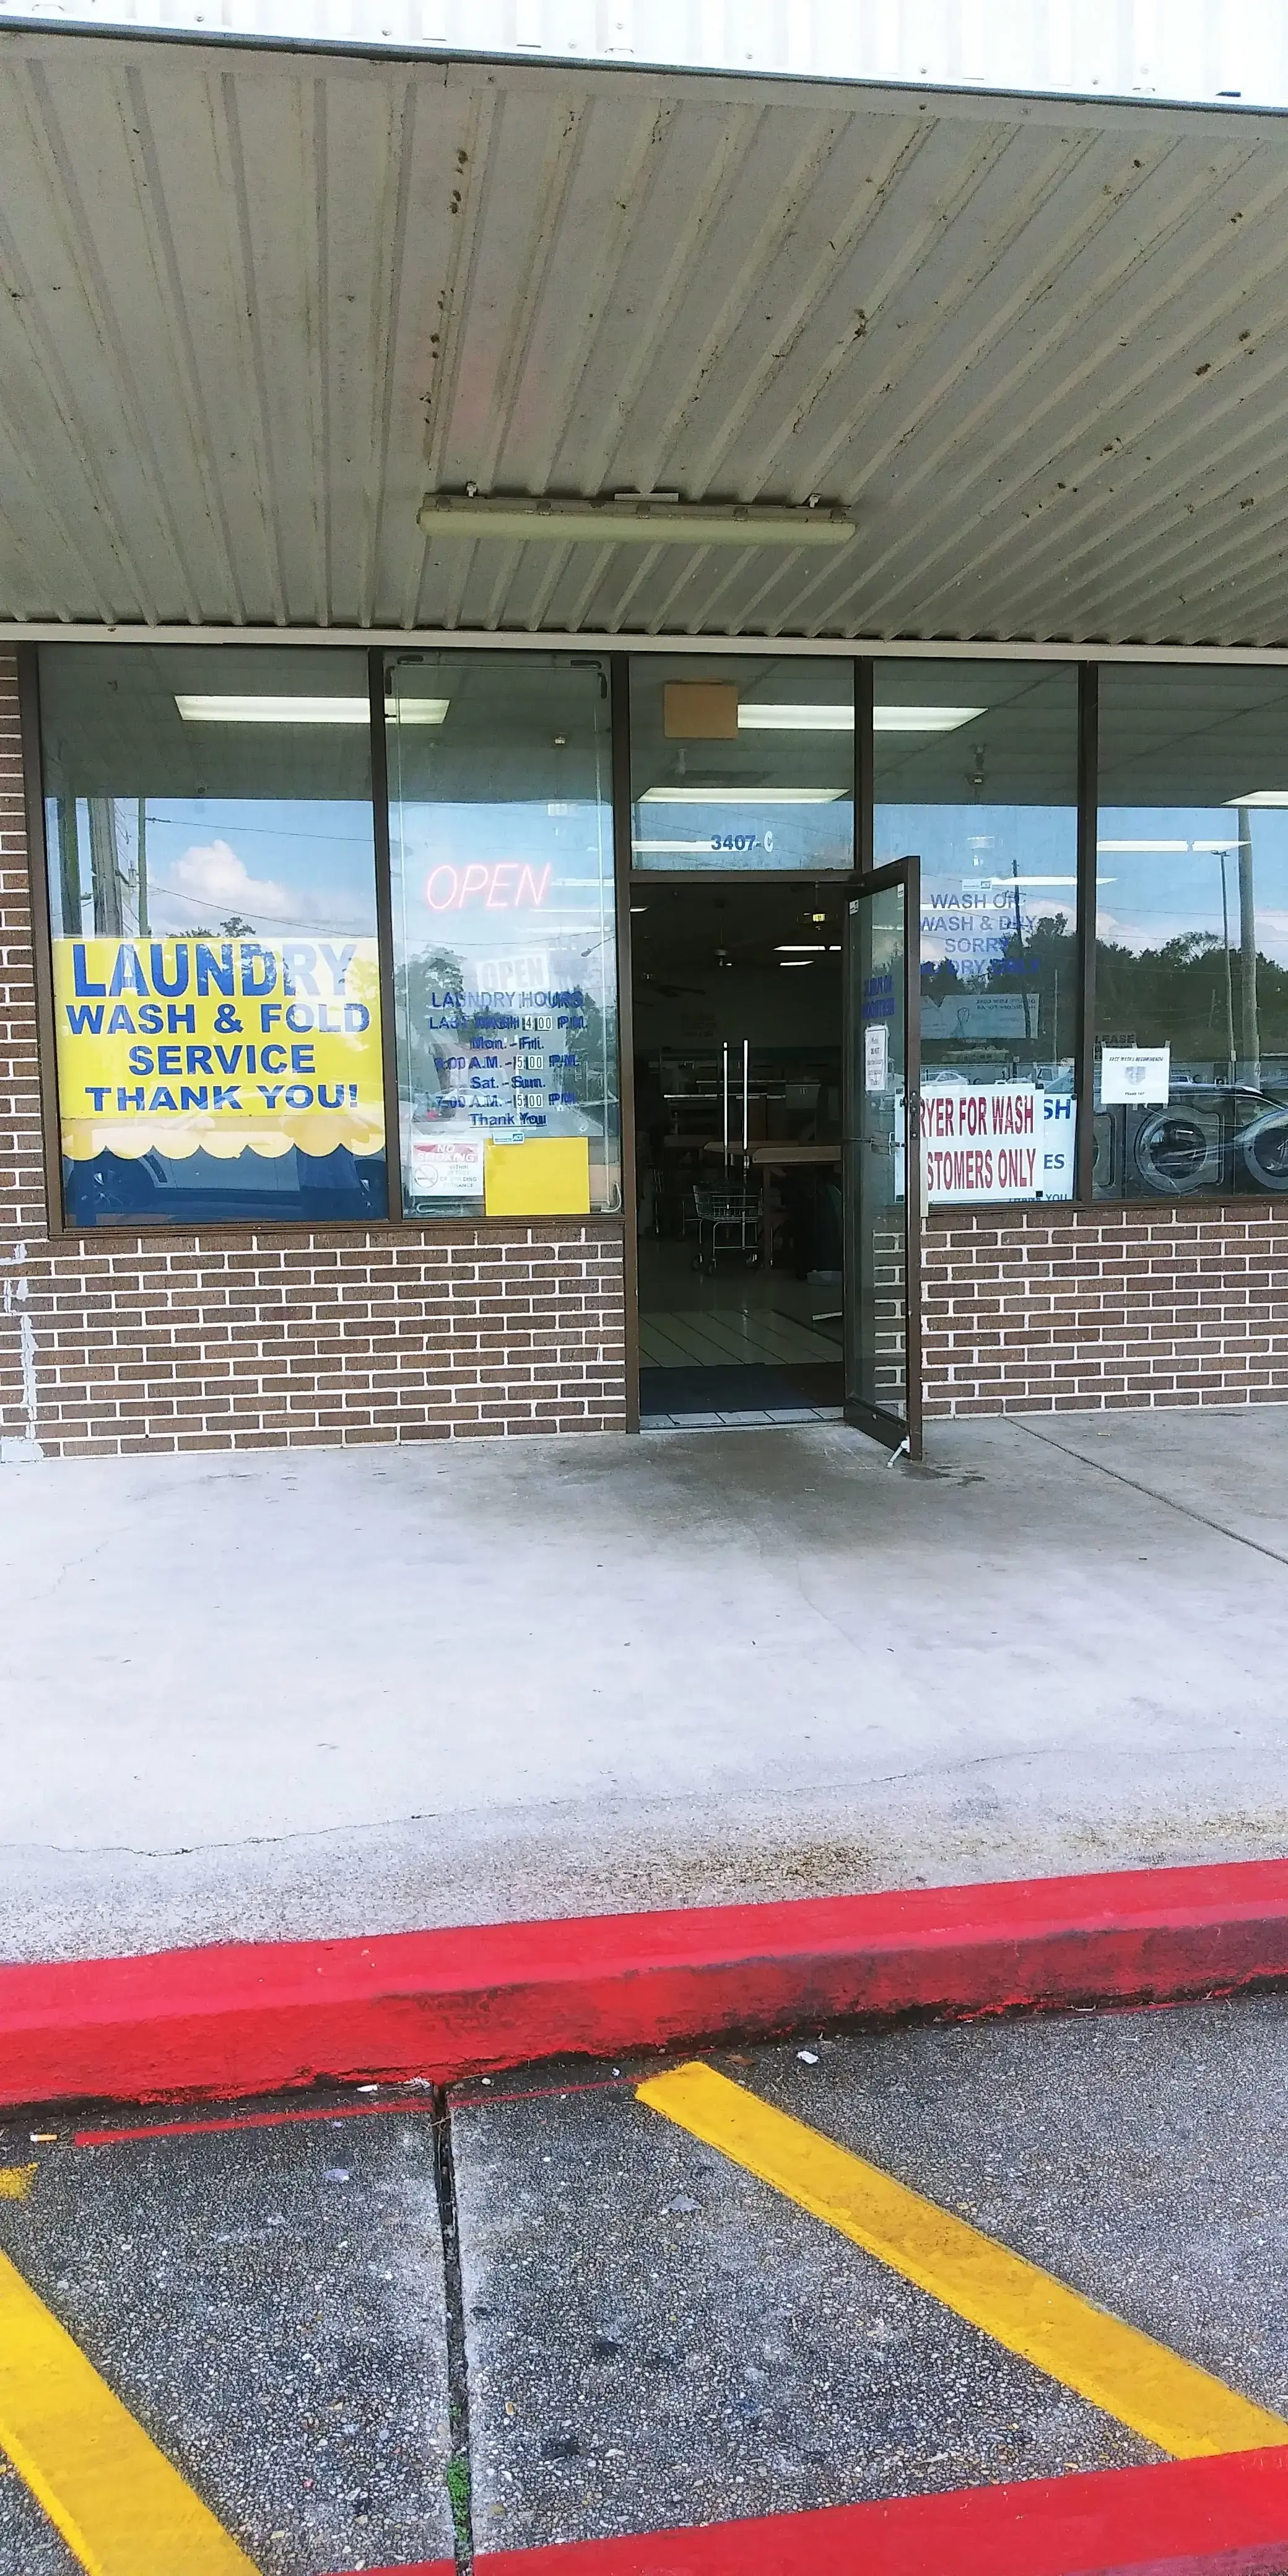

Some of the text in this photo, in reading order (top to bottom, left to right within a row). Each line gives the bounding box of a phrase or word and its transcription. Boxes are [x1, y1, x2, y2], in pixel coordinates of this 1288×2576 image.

[427, 863, 550, 910] OPEN
[931, 894, 986, 908] WASH
[920, 916, 973, 931] WASH
[980, 915, 993, 931] &
[945, 938, 1010, 953] SORRY
[73, 943, 355, 997] LAUNDRY
[482, 957, 544, 991] OPEN
[432, 991, 584, 1008] LAUNDRY HOURS
[66, 1003, 371, 1035] WASH & FOLD
[128, 1044, 315, 1075] SERVICE
[471, 1076, 499, 1089] Sat.
[511, 1076, 546, 1089] Sun.
[85, 1084, 358, 1112] THANK YOU!
[470, 1112, 547, 1126] Thank You
[920, 1095, 1033, 1138] RYER FOR WASH
[417, 1152, 477, 1162] SMOKING
[437, 1144, 456, 1152] NO
[927, 1149, 1036, 1191] STOMERS ONLY
